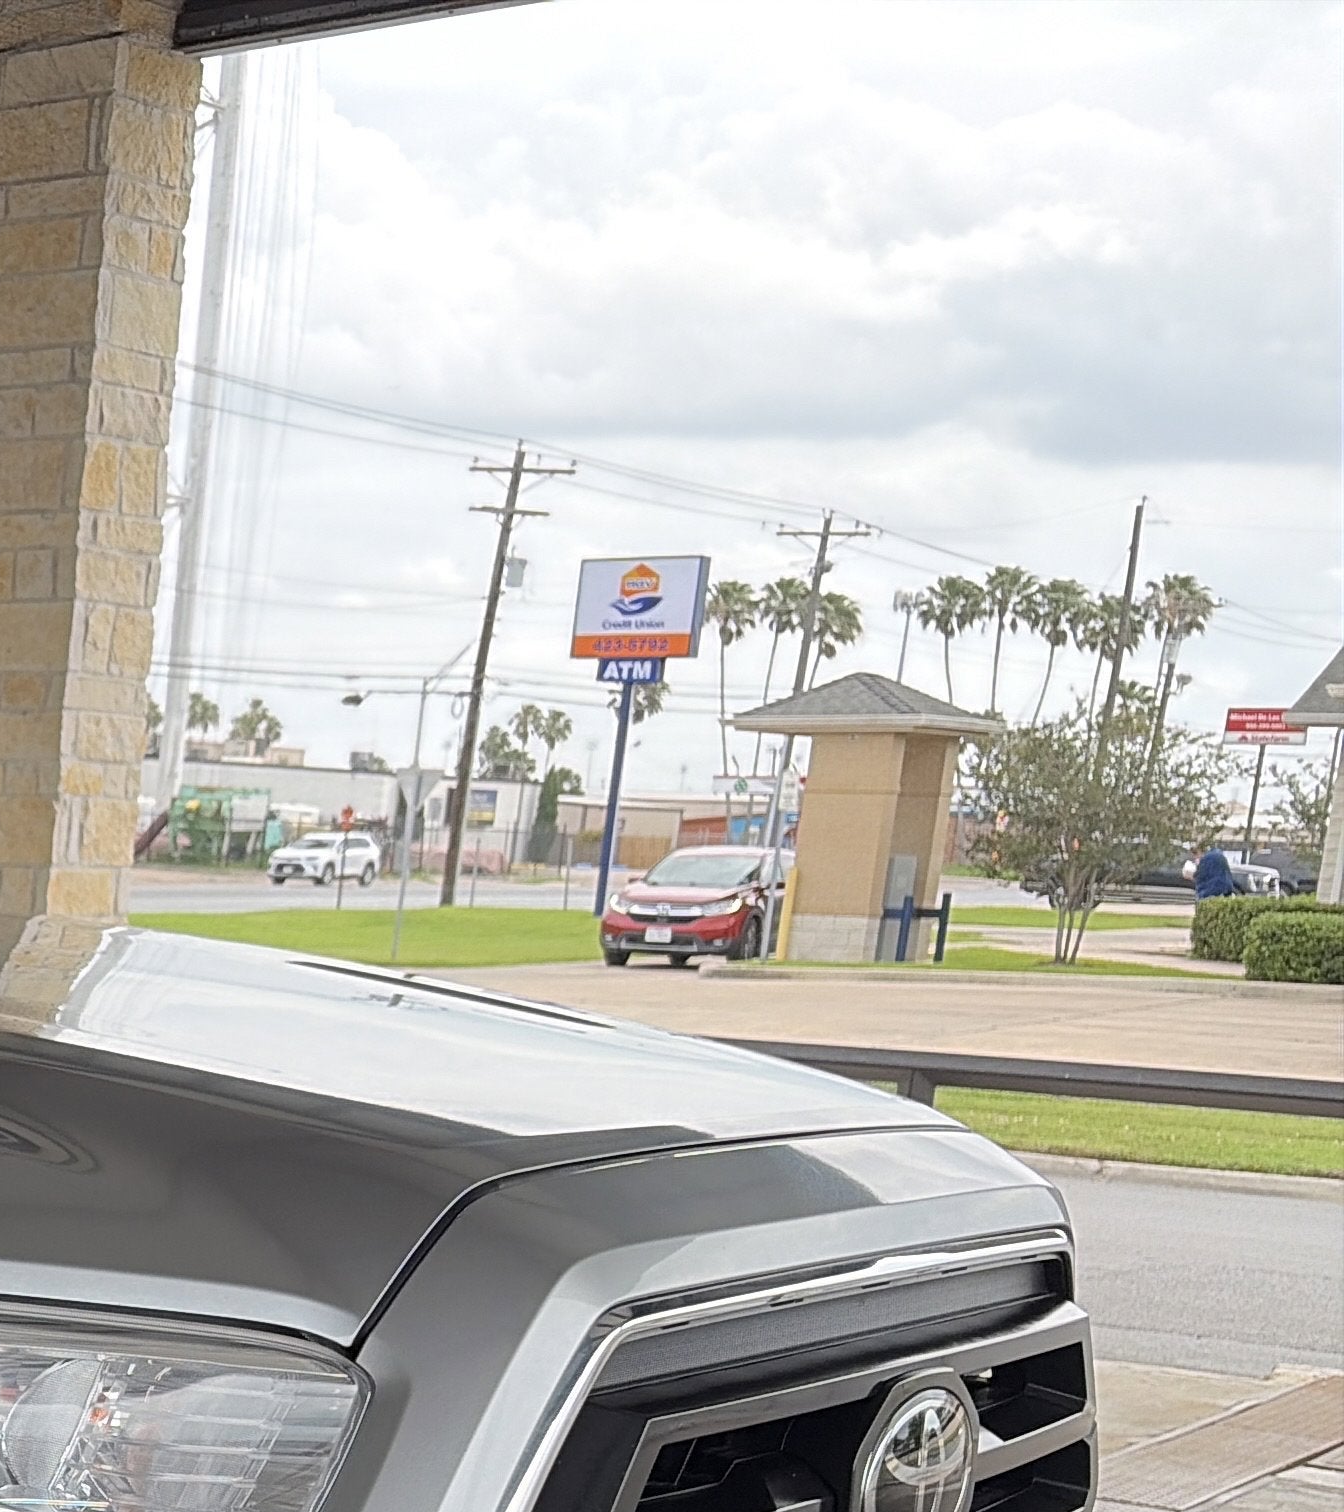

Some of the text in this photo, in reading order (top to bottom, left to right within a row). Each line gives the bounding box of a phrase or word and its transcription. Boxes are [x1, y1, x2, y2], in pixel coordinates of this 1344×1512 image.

[601, 618, 665, 631] Credit Union
[602, 660, 653, 680] ATM
